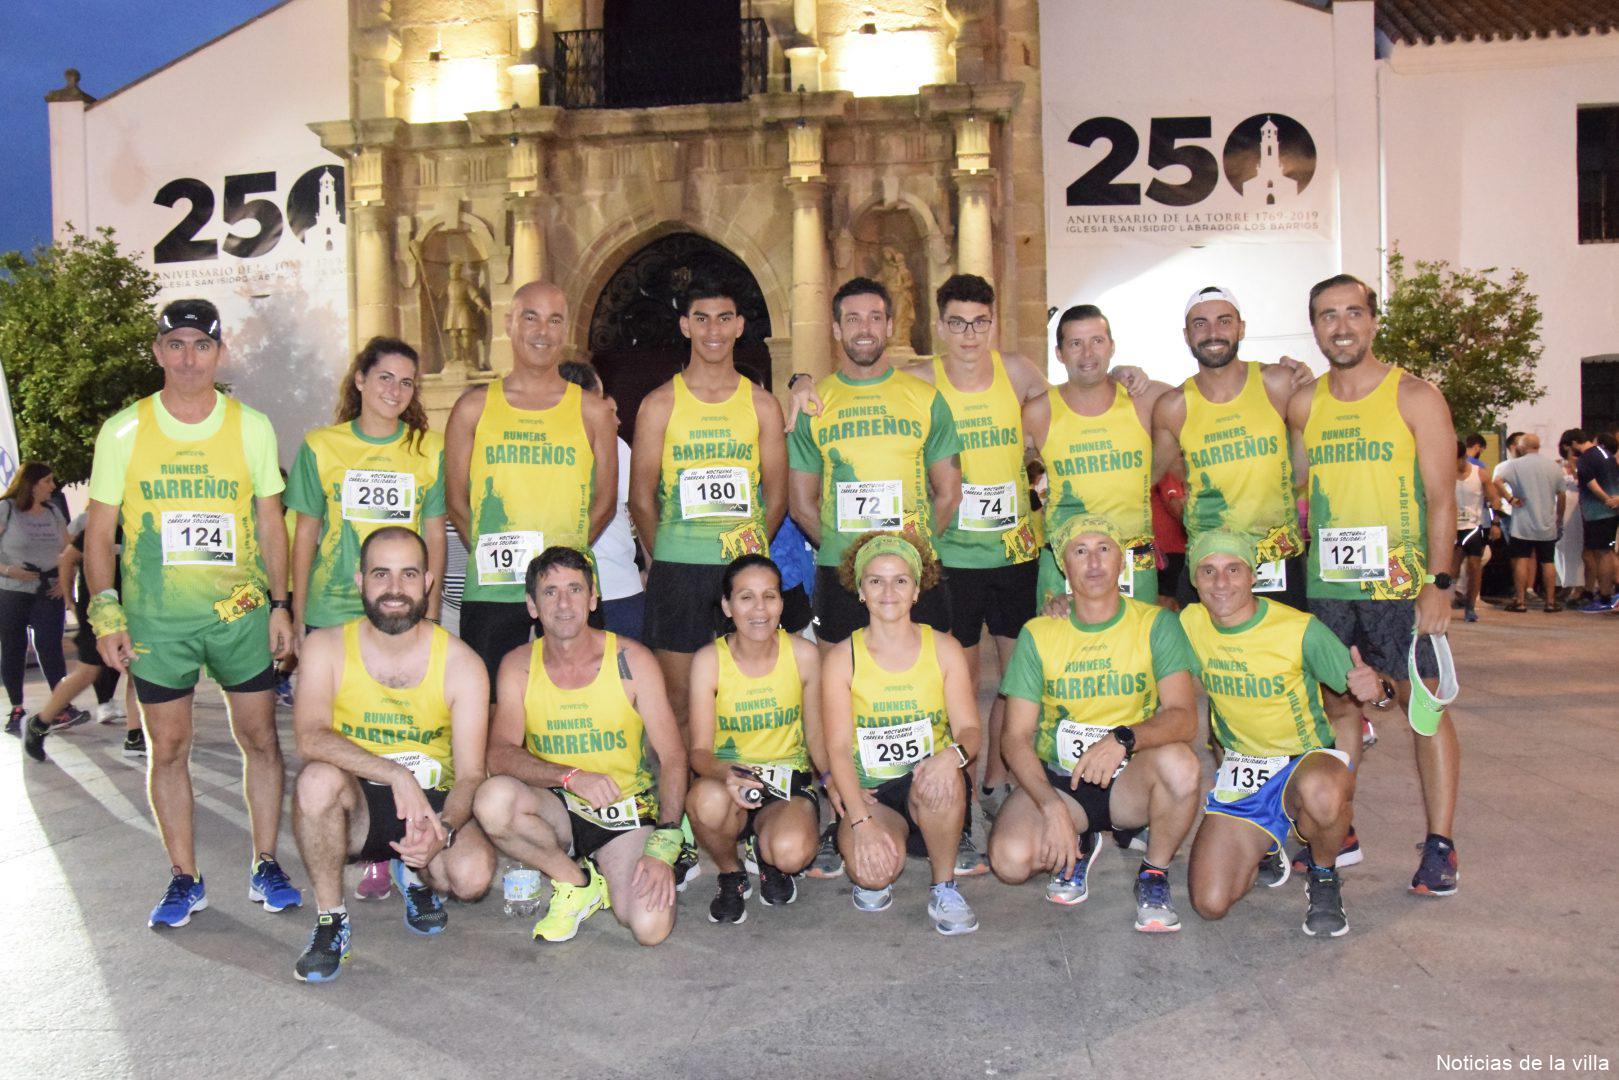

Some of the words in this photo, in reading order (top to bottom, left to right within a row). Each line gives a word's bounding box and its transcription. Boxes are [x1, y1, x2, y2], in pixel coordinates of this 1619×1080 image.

[1066, 113, 1317, 206] 250
[153, 164, 346, 264] 250
[1067, 213, 1158, 224] ANIVERSARIO
[1163, 213, 1179, 223] DE
[1186, 213, 1200, 223] LA
[1207, 212, 1249, 222] TORRE
[1066, 224, 1109, 233] IGLESIA
[1113, 224, 1136, 233] SAN
[1139, 224, 1176, 233] ISIDRO
[1180, 223, 1240, 232] LABRADOR
[1245, 223, 1266, 231] LOS
[1270, 221, 1319, 231] BARRIOS
[838, 405, 888, 419] RUNNERS
[503, 430, 547, 442] RUNNERS
[689, 429, 732, 440] RUNNERS
[818, 415, 923, 446] BARREÑOS
[959, 425, 1018, 450] RREÑOS
[1204, 425, 1247, 444] RUNNERS
[1322, 427, 1361, 441] RUNNERS
[485, 442, 576, 466] BARREÑOS
[673, 439, 754, 461] BARREÑOS
[1069, 439, 1113, 454] RUNNERS
[1191, 435, 1278, 469] BARREÑOS
[161, 464, 209, 475] RUNNERS
[1053, 449, 1143, 476] BARREÑOS
[139, 474, 240, 501] BARREÑOS
[358, 486, 399, 506] 286
[697, 482, 736, 501] 180
[855, 496, 881, 515] 72
[979, 497, 1002, 516] 74
[1400, 512, 1410, 528] LOS
[181, 526, 222, 547] 124
[490, 549, 528, 568] 197
[1331, 544, 1367, 565] 121
[1064, 658, 1112, 673] RUNNERS
[1207, 657, 1248, 672] RUNNERS
[1046, 669, 1147, 700] BARREÑOS
[1202, 672, 1286, 698] ARREÑOS
[735, 697, 777, 713] RUNNERS
[872, 699, 918, 712] RUNNERS
[364, 711, 414, 725] RUNNERS
[546, 717, 593, 731] RUNNERS
[718, 704, 800, 733] BARREÑOS
[876, 739, 919, 762] 295
[1231, 766, 1270, 788] 135
